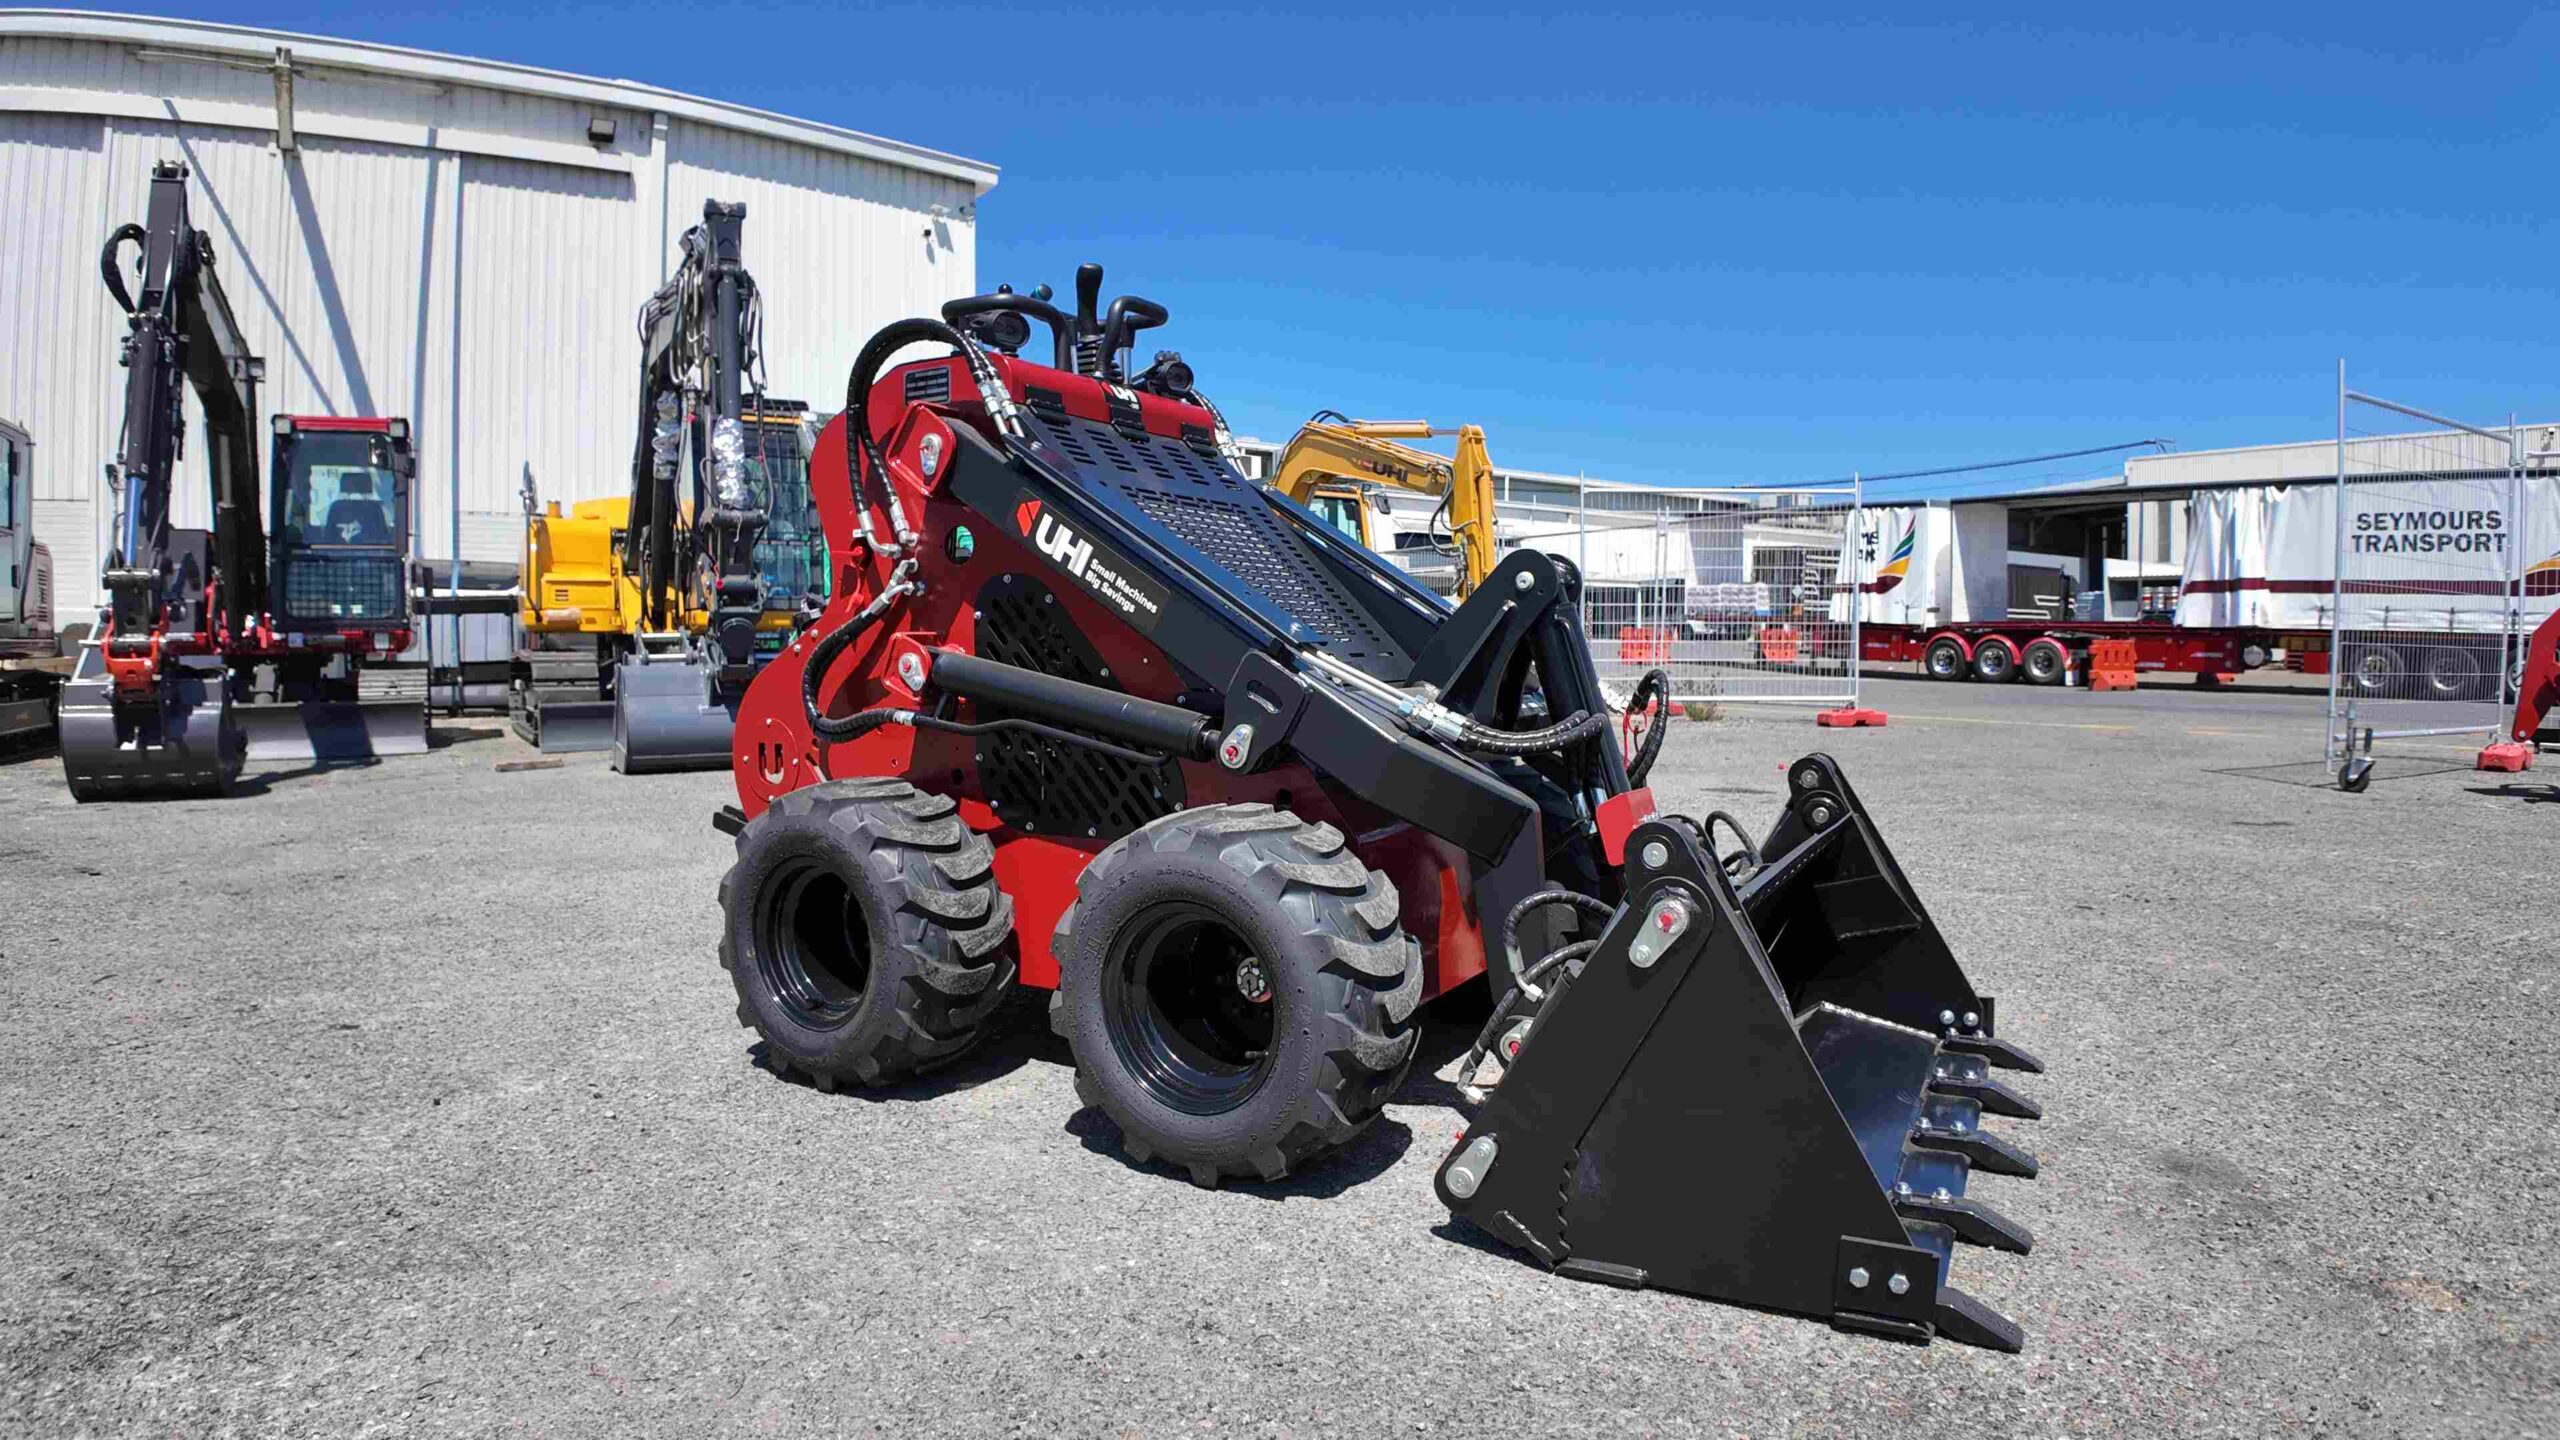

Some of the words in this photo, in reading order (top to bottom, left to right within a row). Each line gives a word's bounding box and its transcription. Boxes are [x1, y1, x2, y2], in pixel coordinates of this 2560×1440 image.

[1372, 461, 1408, 483] UHI
[2356, 510, 2502, 531] SEYMOURS
[1035, 512, 1094, 578] UHI
[2351, 533, 2507, 553] TRANSPORT
[1084, 569, 1101, 590] Big
[1100, 582, 1136, 613] Savings
[1090, 558, 1117, 583] Small
[1115, 575, 1158, 614] Machines
